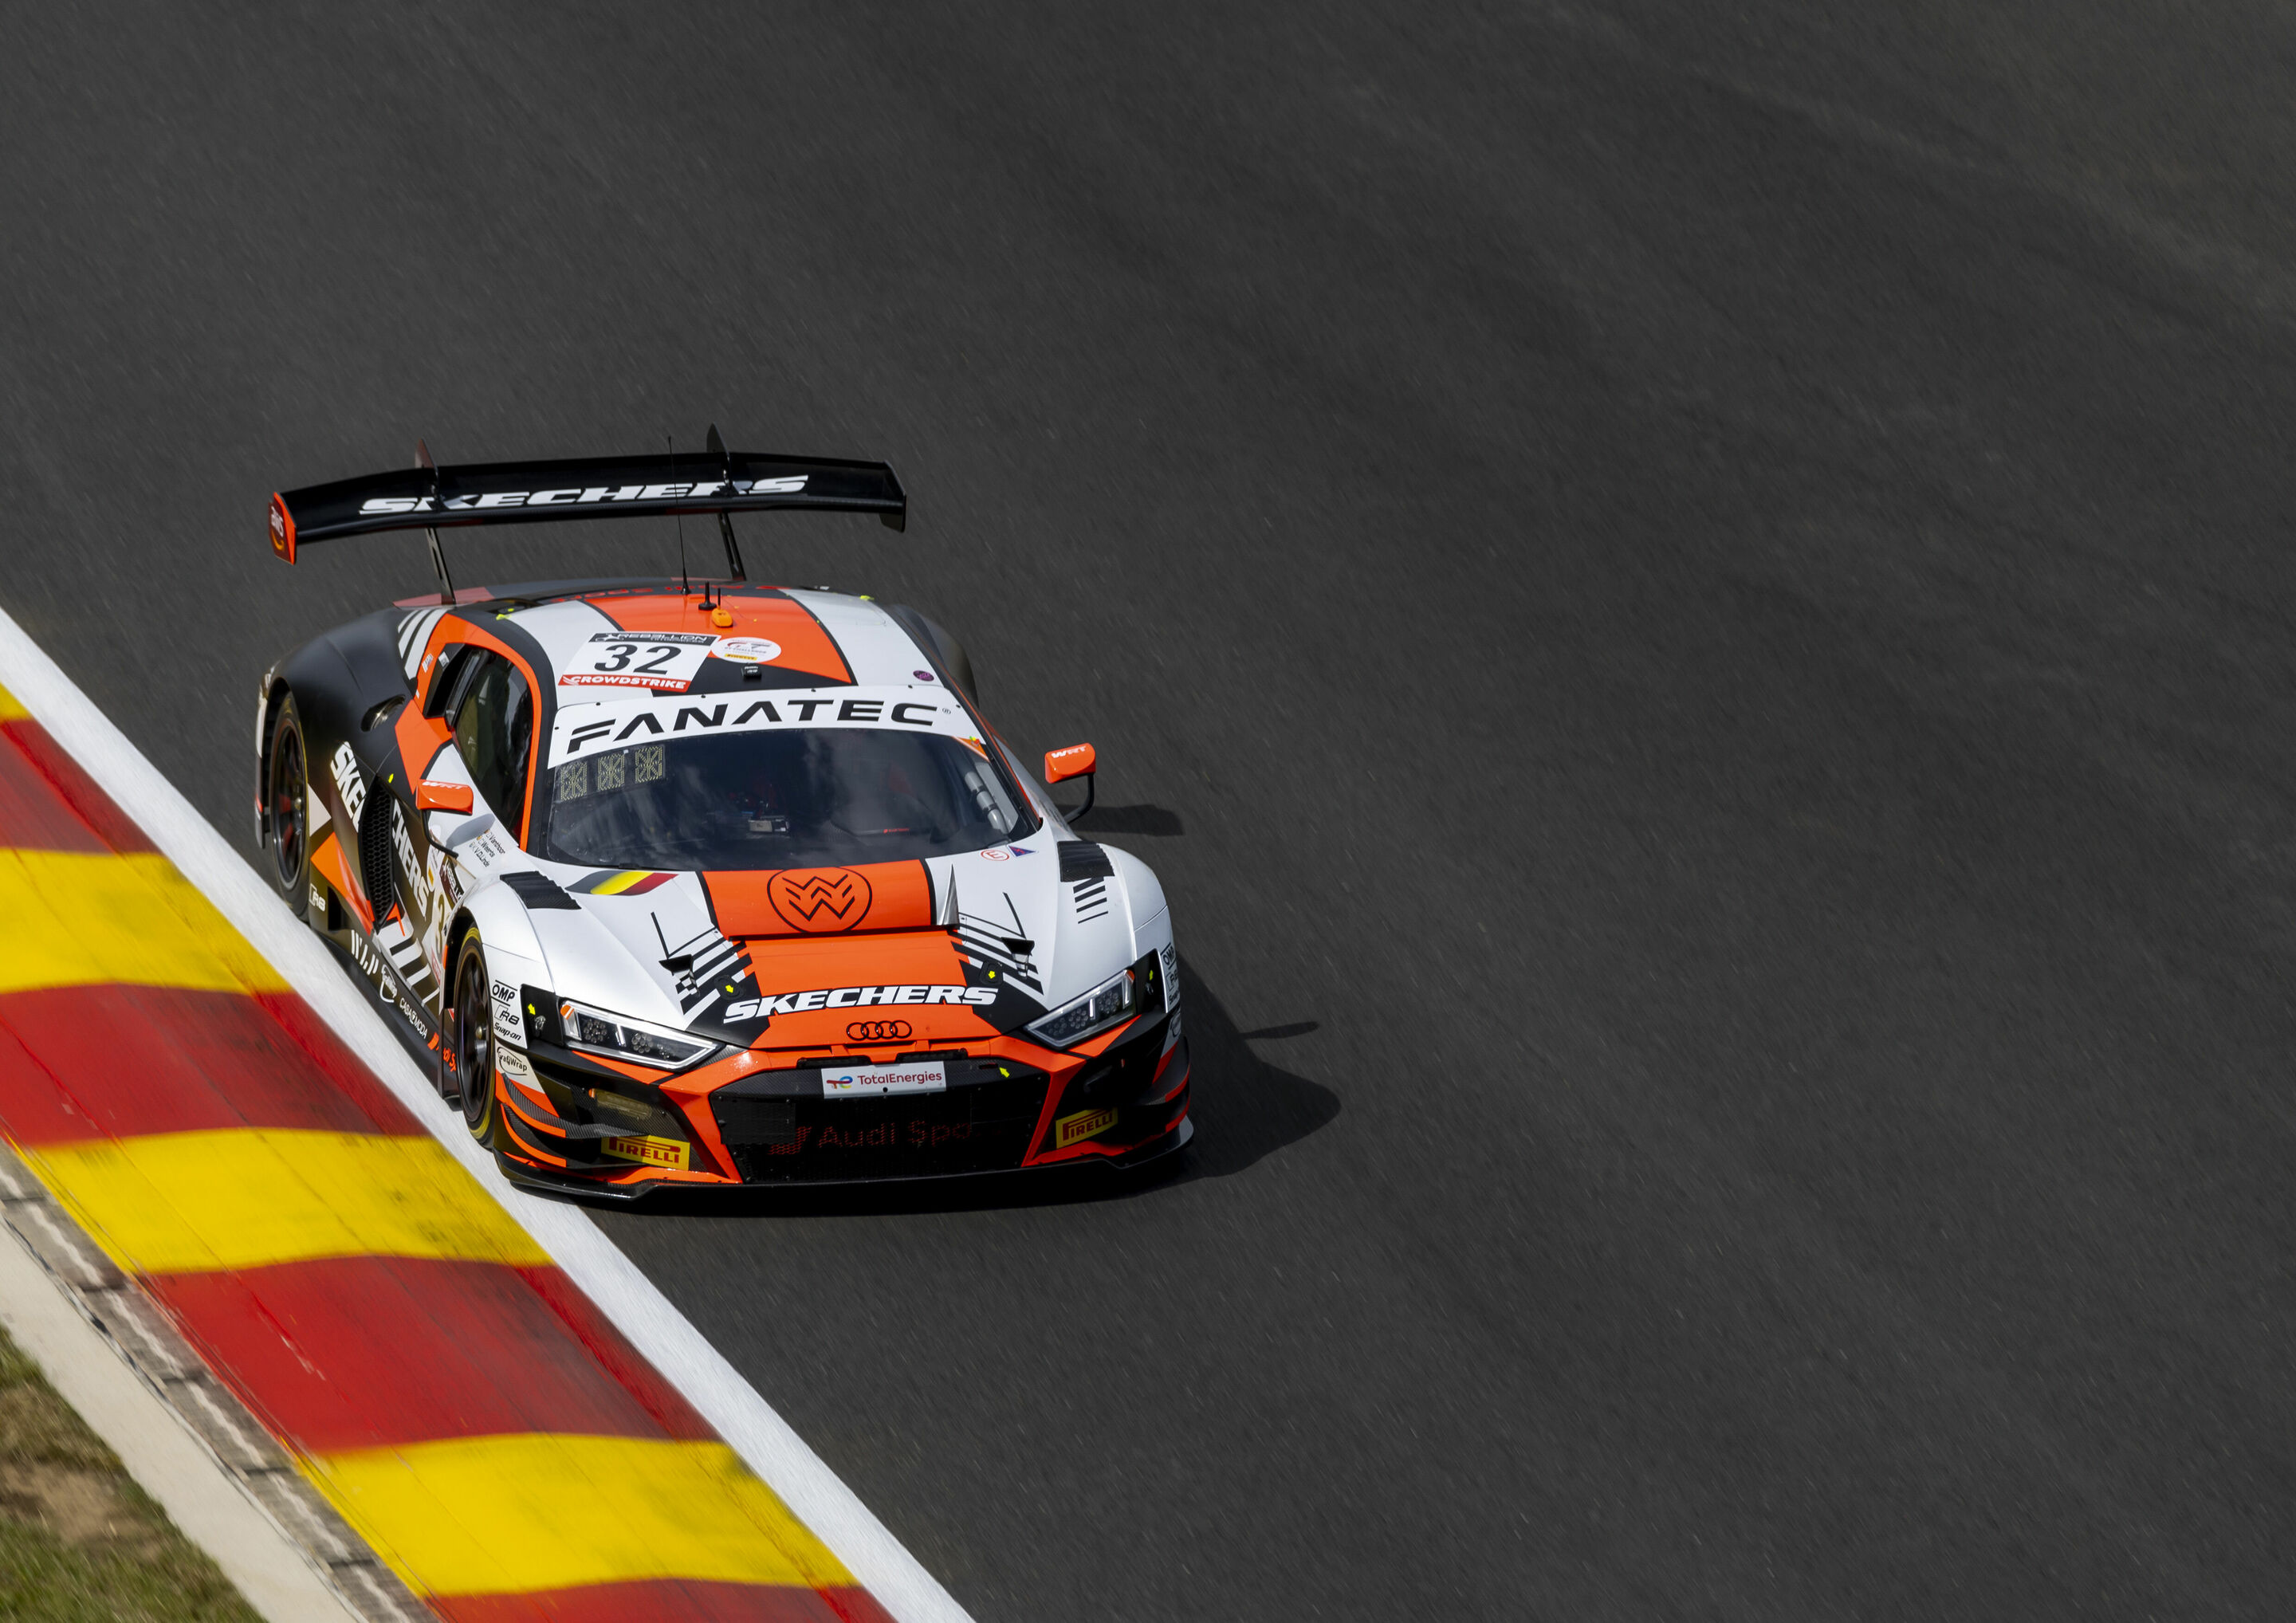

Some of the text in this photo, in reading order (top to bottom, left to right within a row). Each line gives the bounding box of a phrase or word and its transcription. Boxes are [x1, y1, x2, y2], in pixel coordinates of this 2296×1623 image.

[360, 474, 808, 515] SKECHERS
[594, 644, 682, 675] 32
[569, 676, 686, 690] CROWDSTRIKE
[567, 699, 938, 754] FANATEC
[492, 984, 516, 1003] OMP
[723, 985, 999, 1024] SKECHERS
[494, 1022, 521, 1041] Snap-on
[499, 1010, 520, 1025] R8
[857, 1071, 942, 1085] TotalEnergies
[818, 1120, 971, 1148] Audi Spo
[1063, 1110, 1113, 1142] PIRELLI
[608, 1136, 682, 1164] PIRELLI
